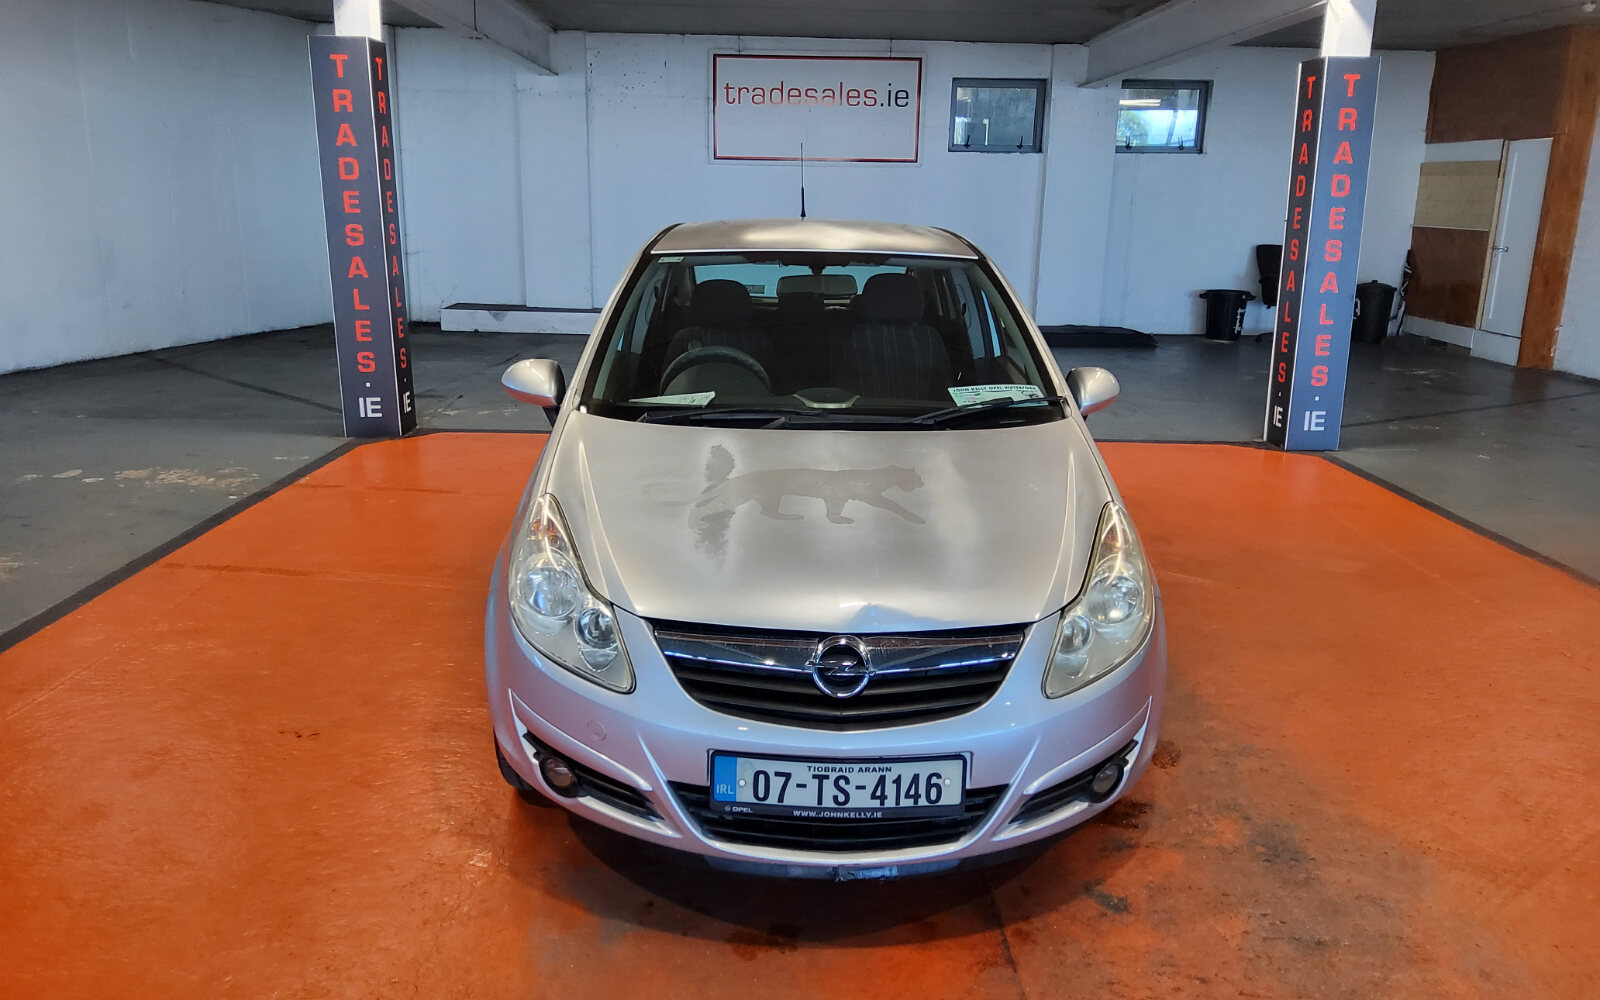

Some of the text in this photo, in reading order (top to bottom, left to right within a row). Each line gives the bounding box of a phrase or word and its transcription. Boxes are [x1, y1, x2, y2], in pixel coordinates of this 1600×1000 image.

[724, 81, 909, 107] tradesales.ie
[807, 765, 854, 774] TIOBRAID
[716, 783, 735, 795] IRL
[752, 769, 943, 807] 07-TS-4146
[793, 809, 883, 819] WWW.JOHNKELLY.IE
